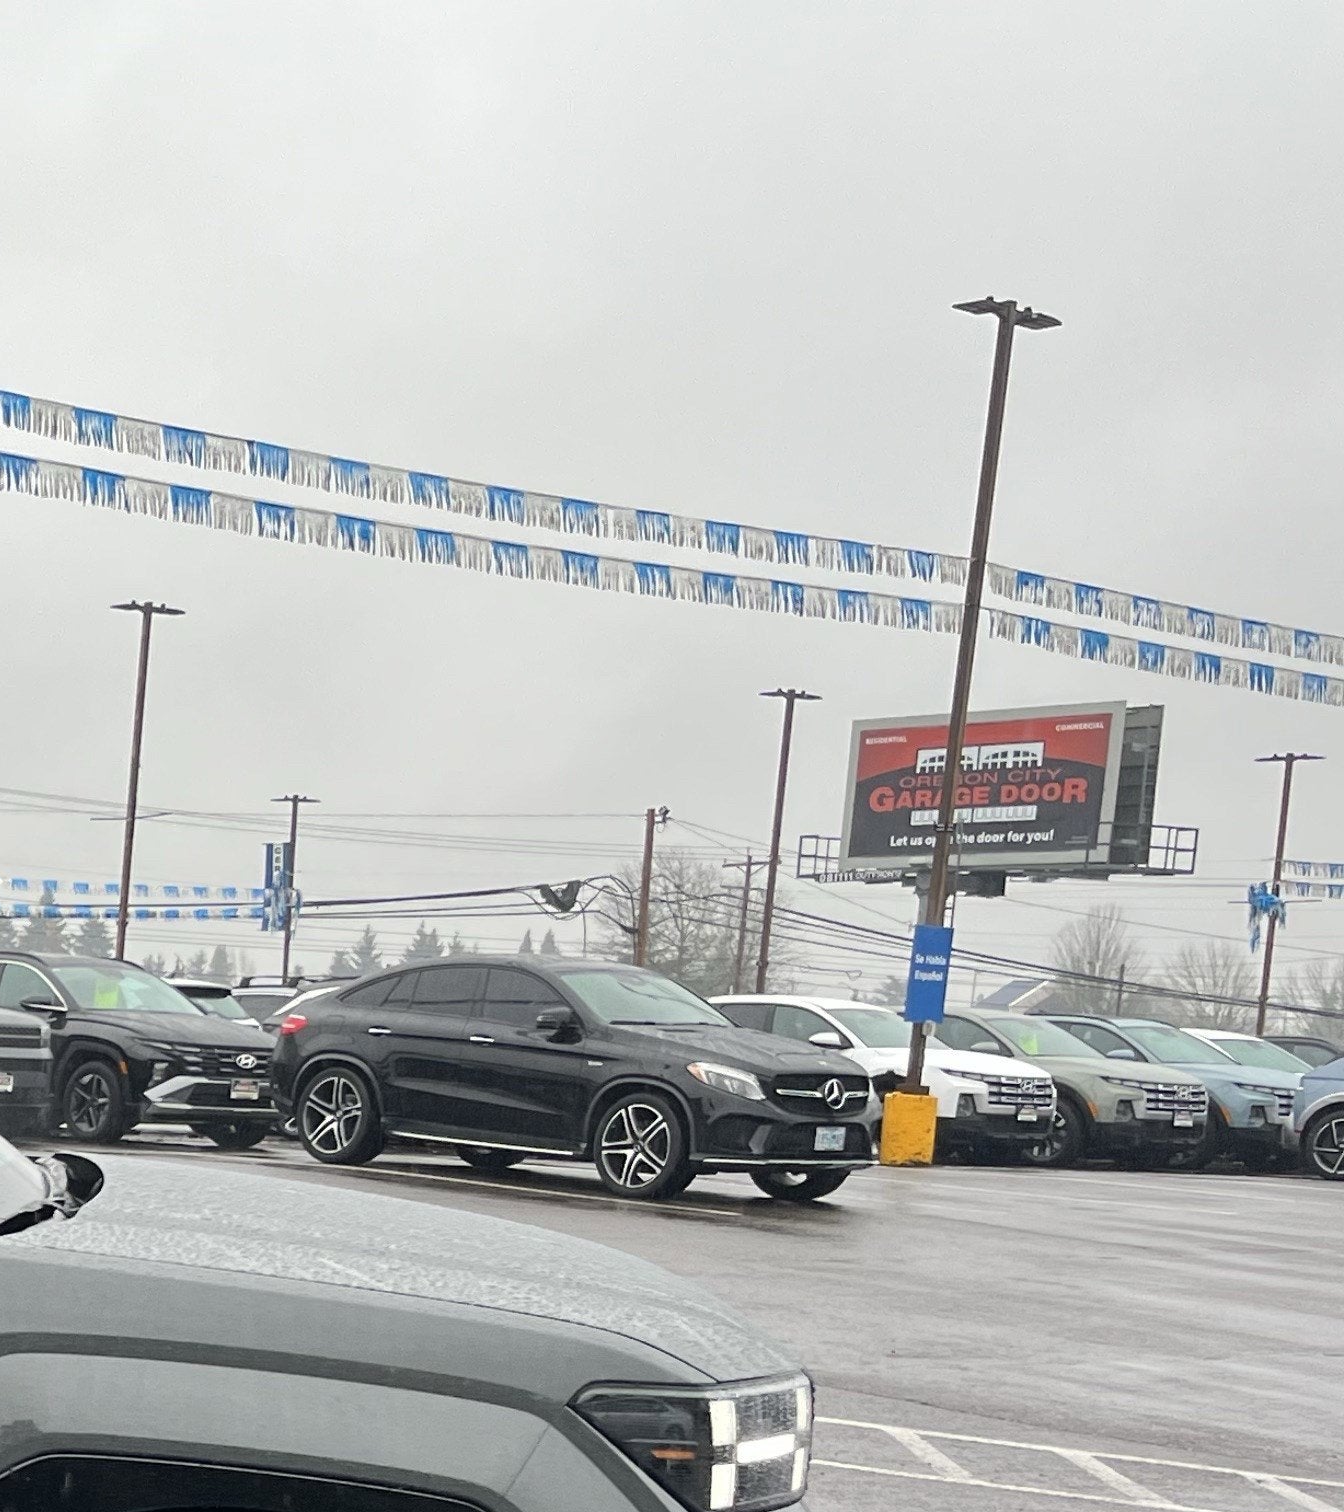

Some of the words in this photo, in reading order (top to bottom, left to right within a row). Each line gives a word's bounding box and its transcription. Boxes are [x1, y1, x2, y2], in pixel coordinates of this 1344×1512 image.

[899, 772, 998, 788] OREON
[1008, 768, 1062, 783] CITY
[1000, 777, 1088, 804] DOOR
[889, 835, 908, 847] Let
[910, 836, 923, 846] us
[977, 831, 1005, 844] door
[1007, 830, 1024, 842] for
[1026, 828, 1055, 844] you!
